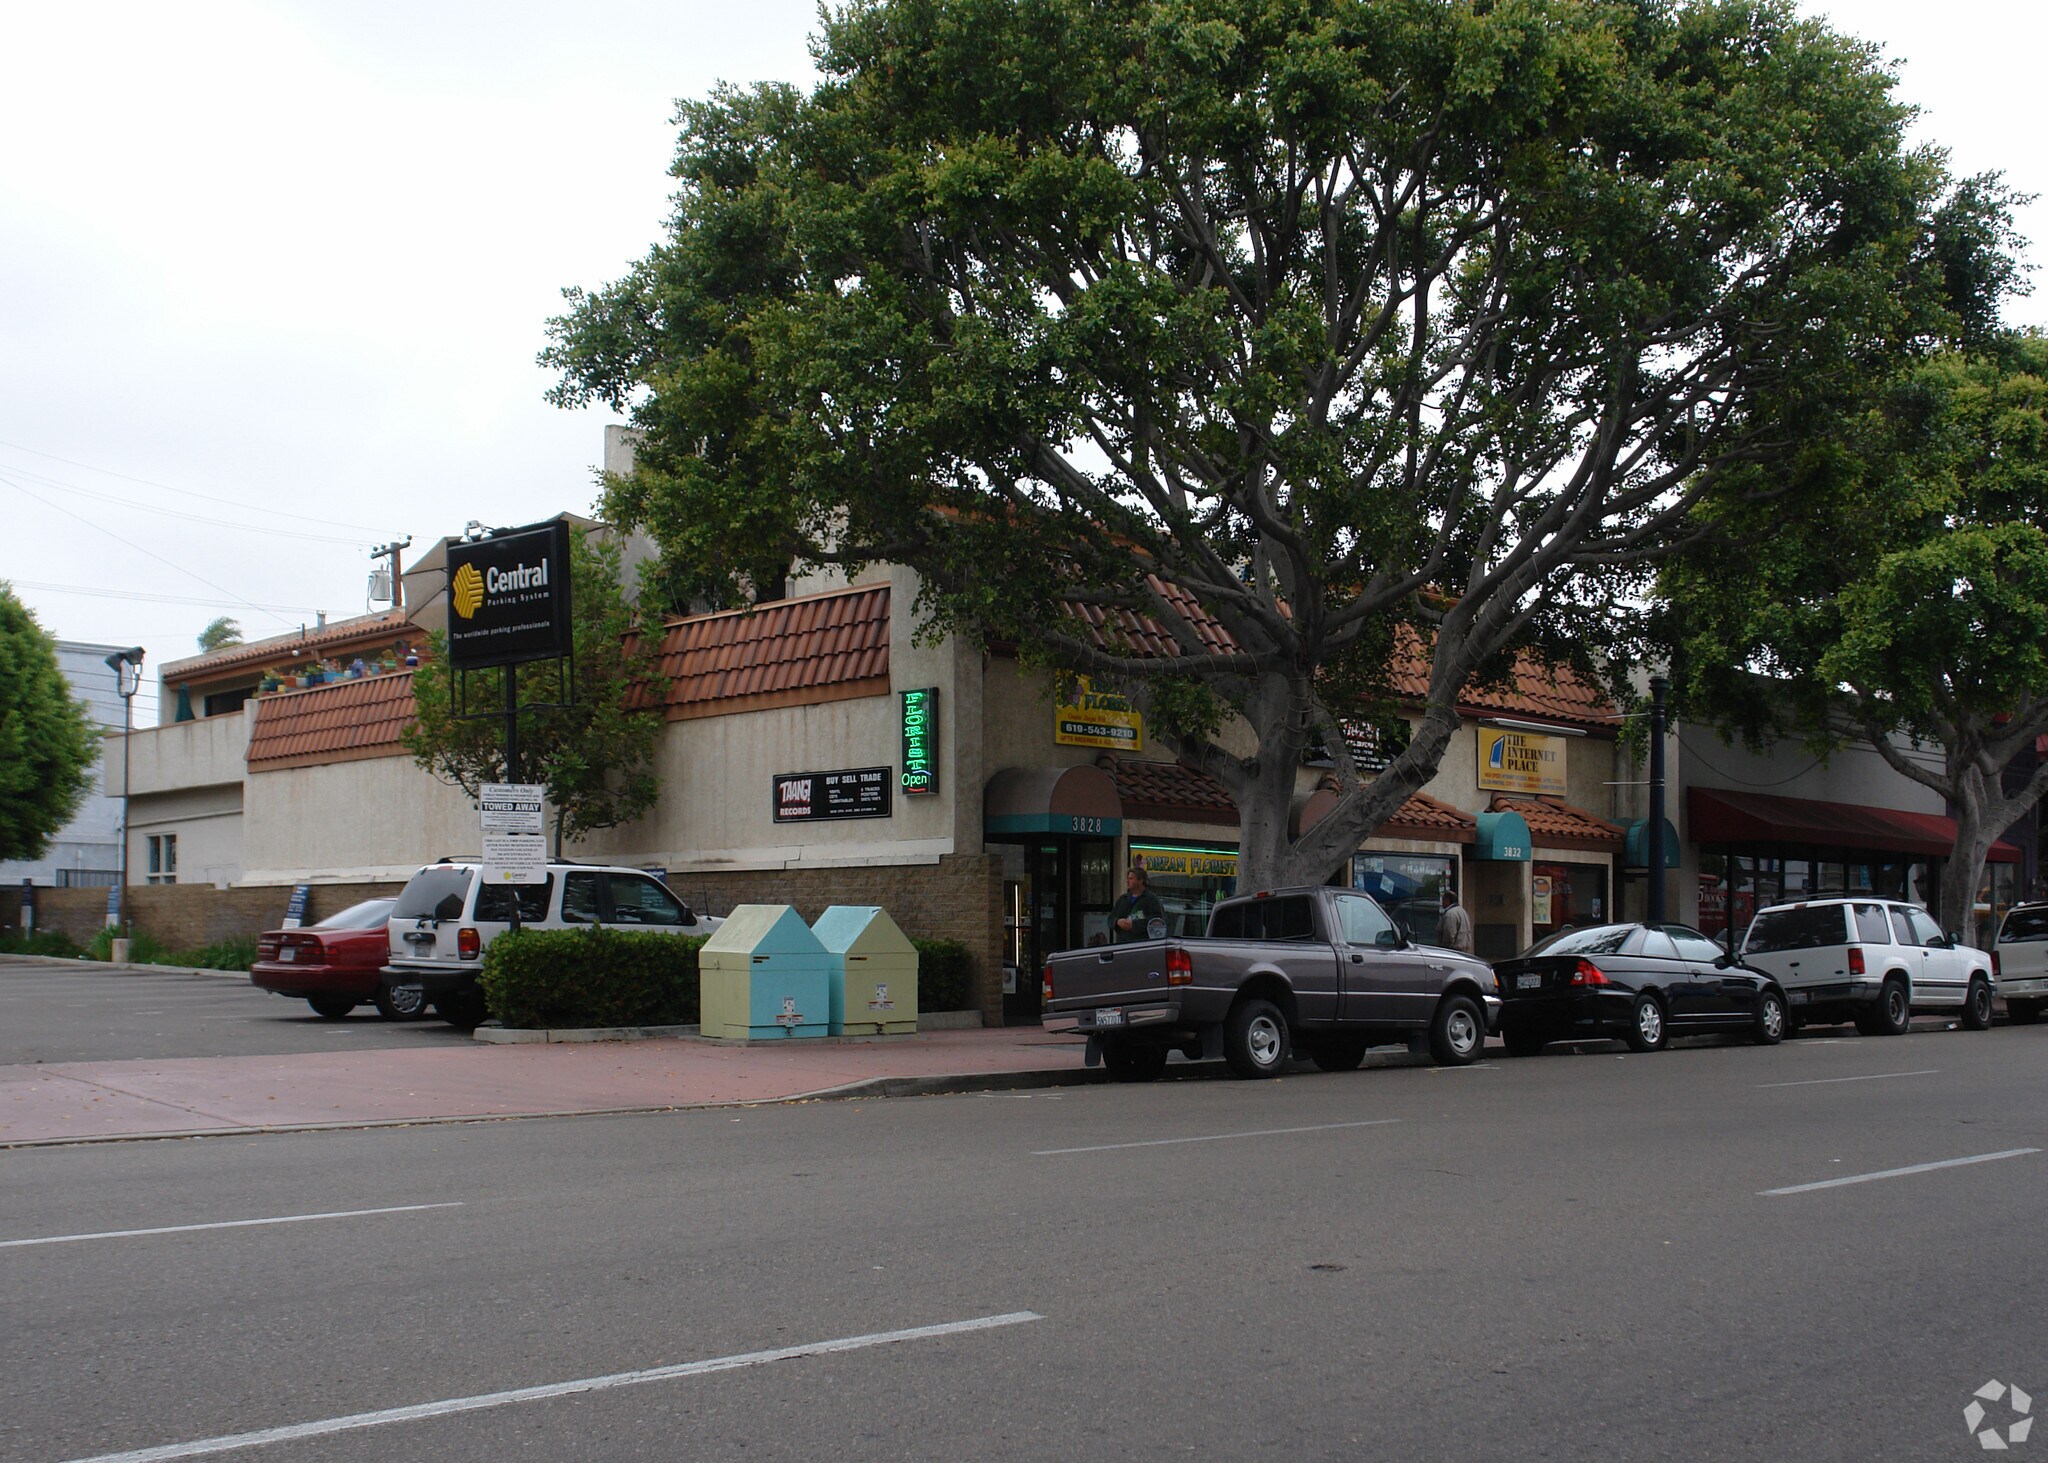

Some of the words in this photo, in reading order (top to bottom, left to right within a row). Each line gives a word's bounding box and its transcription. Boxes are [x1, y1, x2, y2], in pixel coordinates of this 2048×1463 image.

[487, 558, 549, 594] Central
[488, 597, 516, 606] Parking
[520, 592, 549, 601] System
[464, 630, 489, 638] worldwide
[491, 625, 511, 635] parking
[512, 620, 550, 633] professionals
[1066, 724, 1133, 737] 619-543-9210
[1507, 735, 1526, 747] THE
[1508, 747, 1556, 761] INTERNET
[1508, 760, 1538, 772] PLACE
[826, 776, 839, 785] BUY
[842, 774, 857, 784] SELL
[860, 773, 881, 781] TRADE
[901, 773, 928, 788] Open
[780, 779, 811, 802] TAANG!
[780, 806, 811, 815] RECORDS
[1073, 817, 1101, 832] 3828
[1504, 847, 1521, 857] 3832
[1146, 856, 1186, 872] DREAM
[1191, 857, 1236, 876] FLORIST
